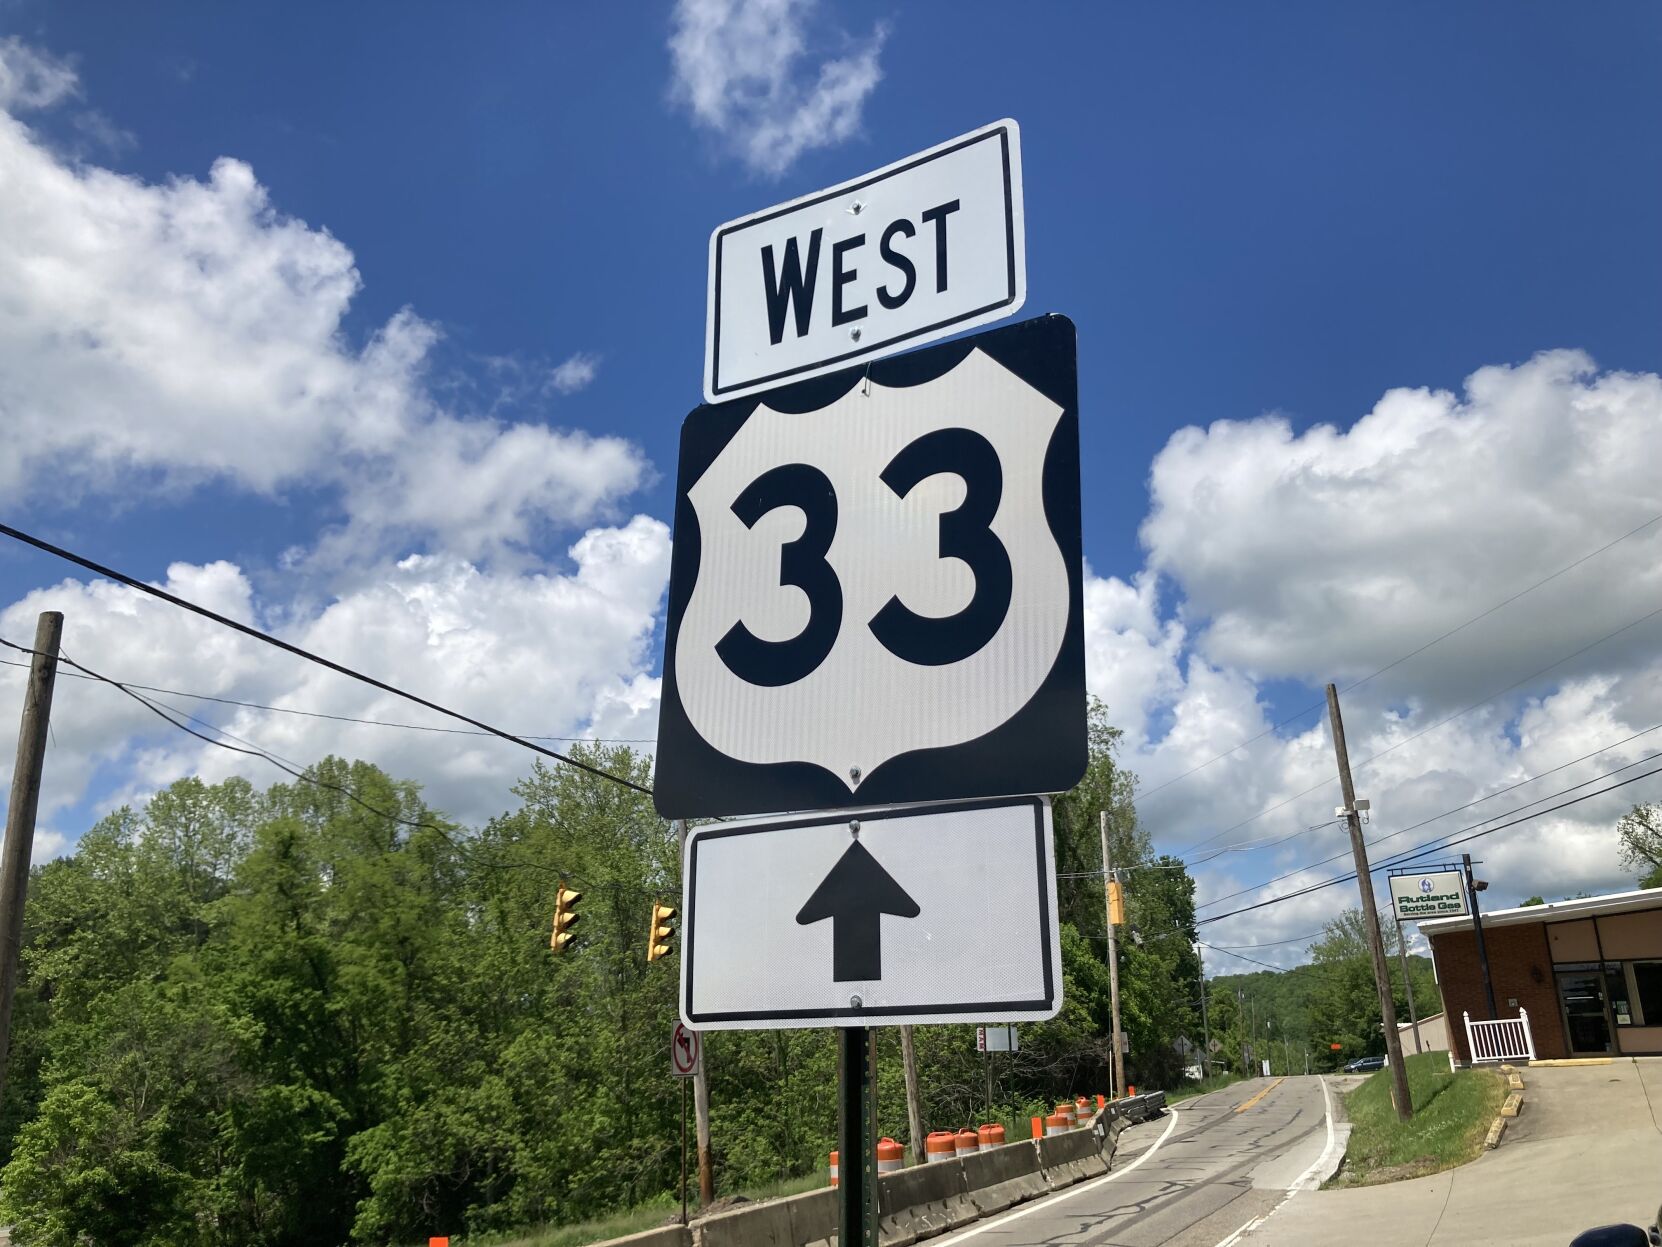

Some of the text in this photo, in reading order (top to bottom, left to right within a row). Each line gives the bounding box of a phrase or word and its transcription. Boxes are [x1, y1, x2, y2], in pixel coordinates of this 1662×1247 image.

[760, 198, 960, 346] WEST
[714, 427, 1013, 688] 33
[1398, 892, 1460, 904] Rutland
[1400, 904, 1435, 912] Bottle
